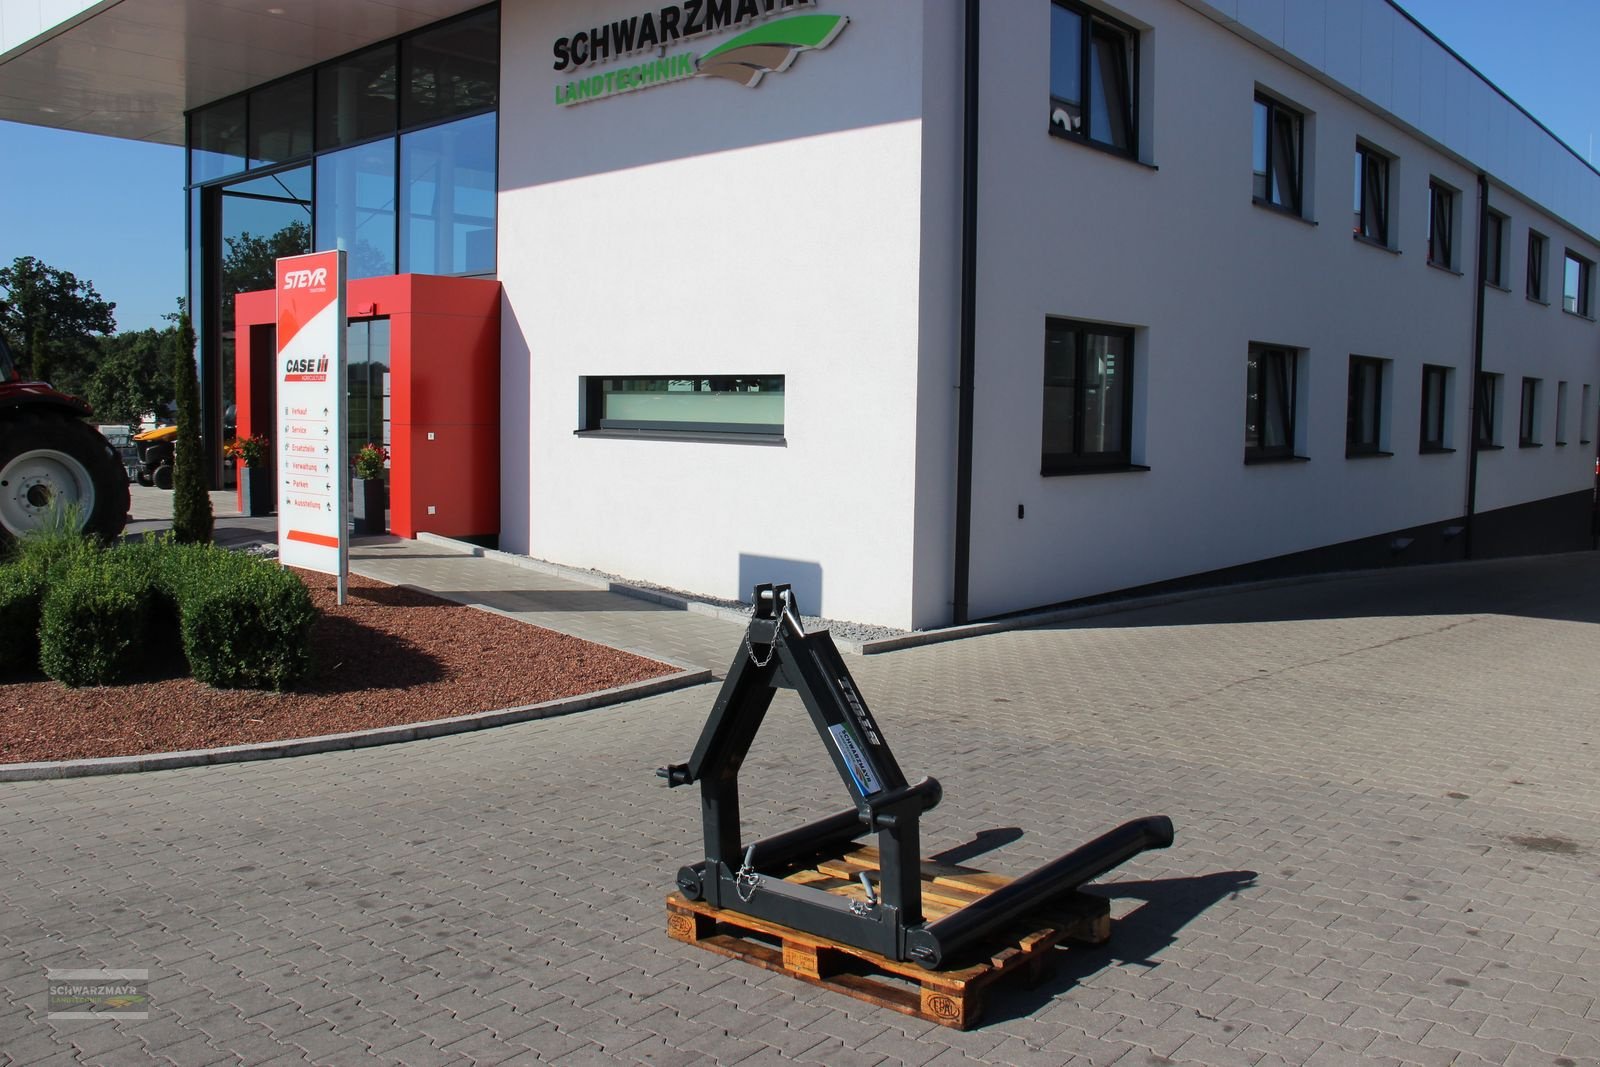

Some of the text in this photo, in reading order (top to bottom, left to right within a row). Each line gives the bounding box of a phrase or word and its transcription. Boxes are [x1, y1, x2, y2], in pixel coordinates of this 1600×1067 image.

[553, 0, 812, 70] SCHWARZMA
[555, 52, 695, 105] LANDTECHNIK
[284, 267, 327, 289] STEYR
[286, 358, 315, 373] CASE
[291, 425, 307, 434] Service
[291, 444, 316, 453] Ersatzteile
[292, 463, 318, 472] Verwaltung
[292, 480, 309, 489] Parken
[294, 499, 321, 511] Ausstellung
[841, 729, 872, 783] SCHWARZMAYR
